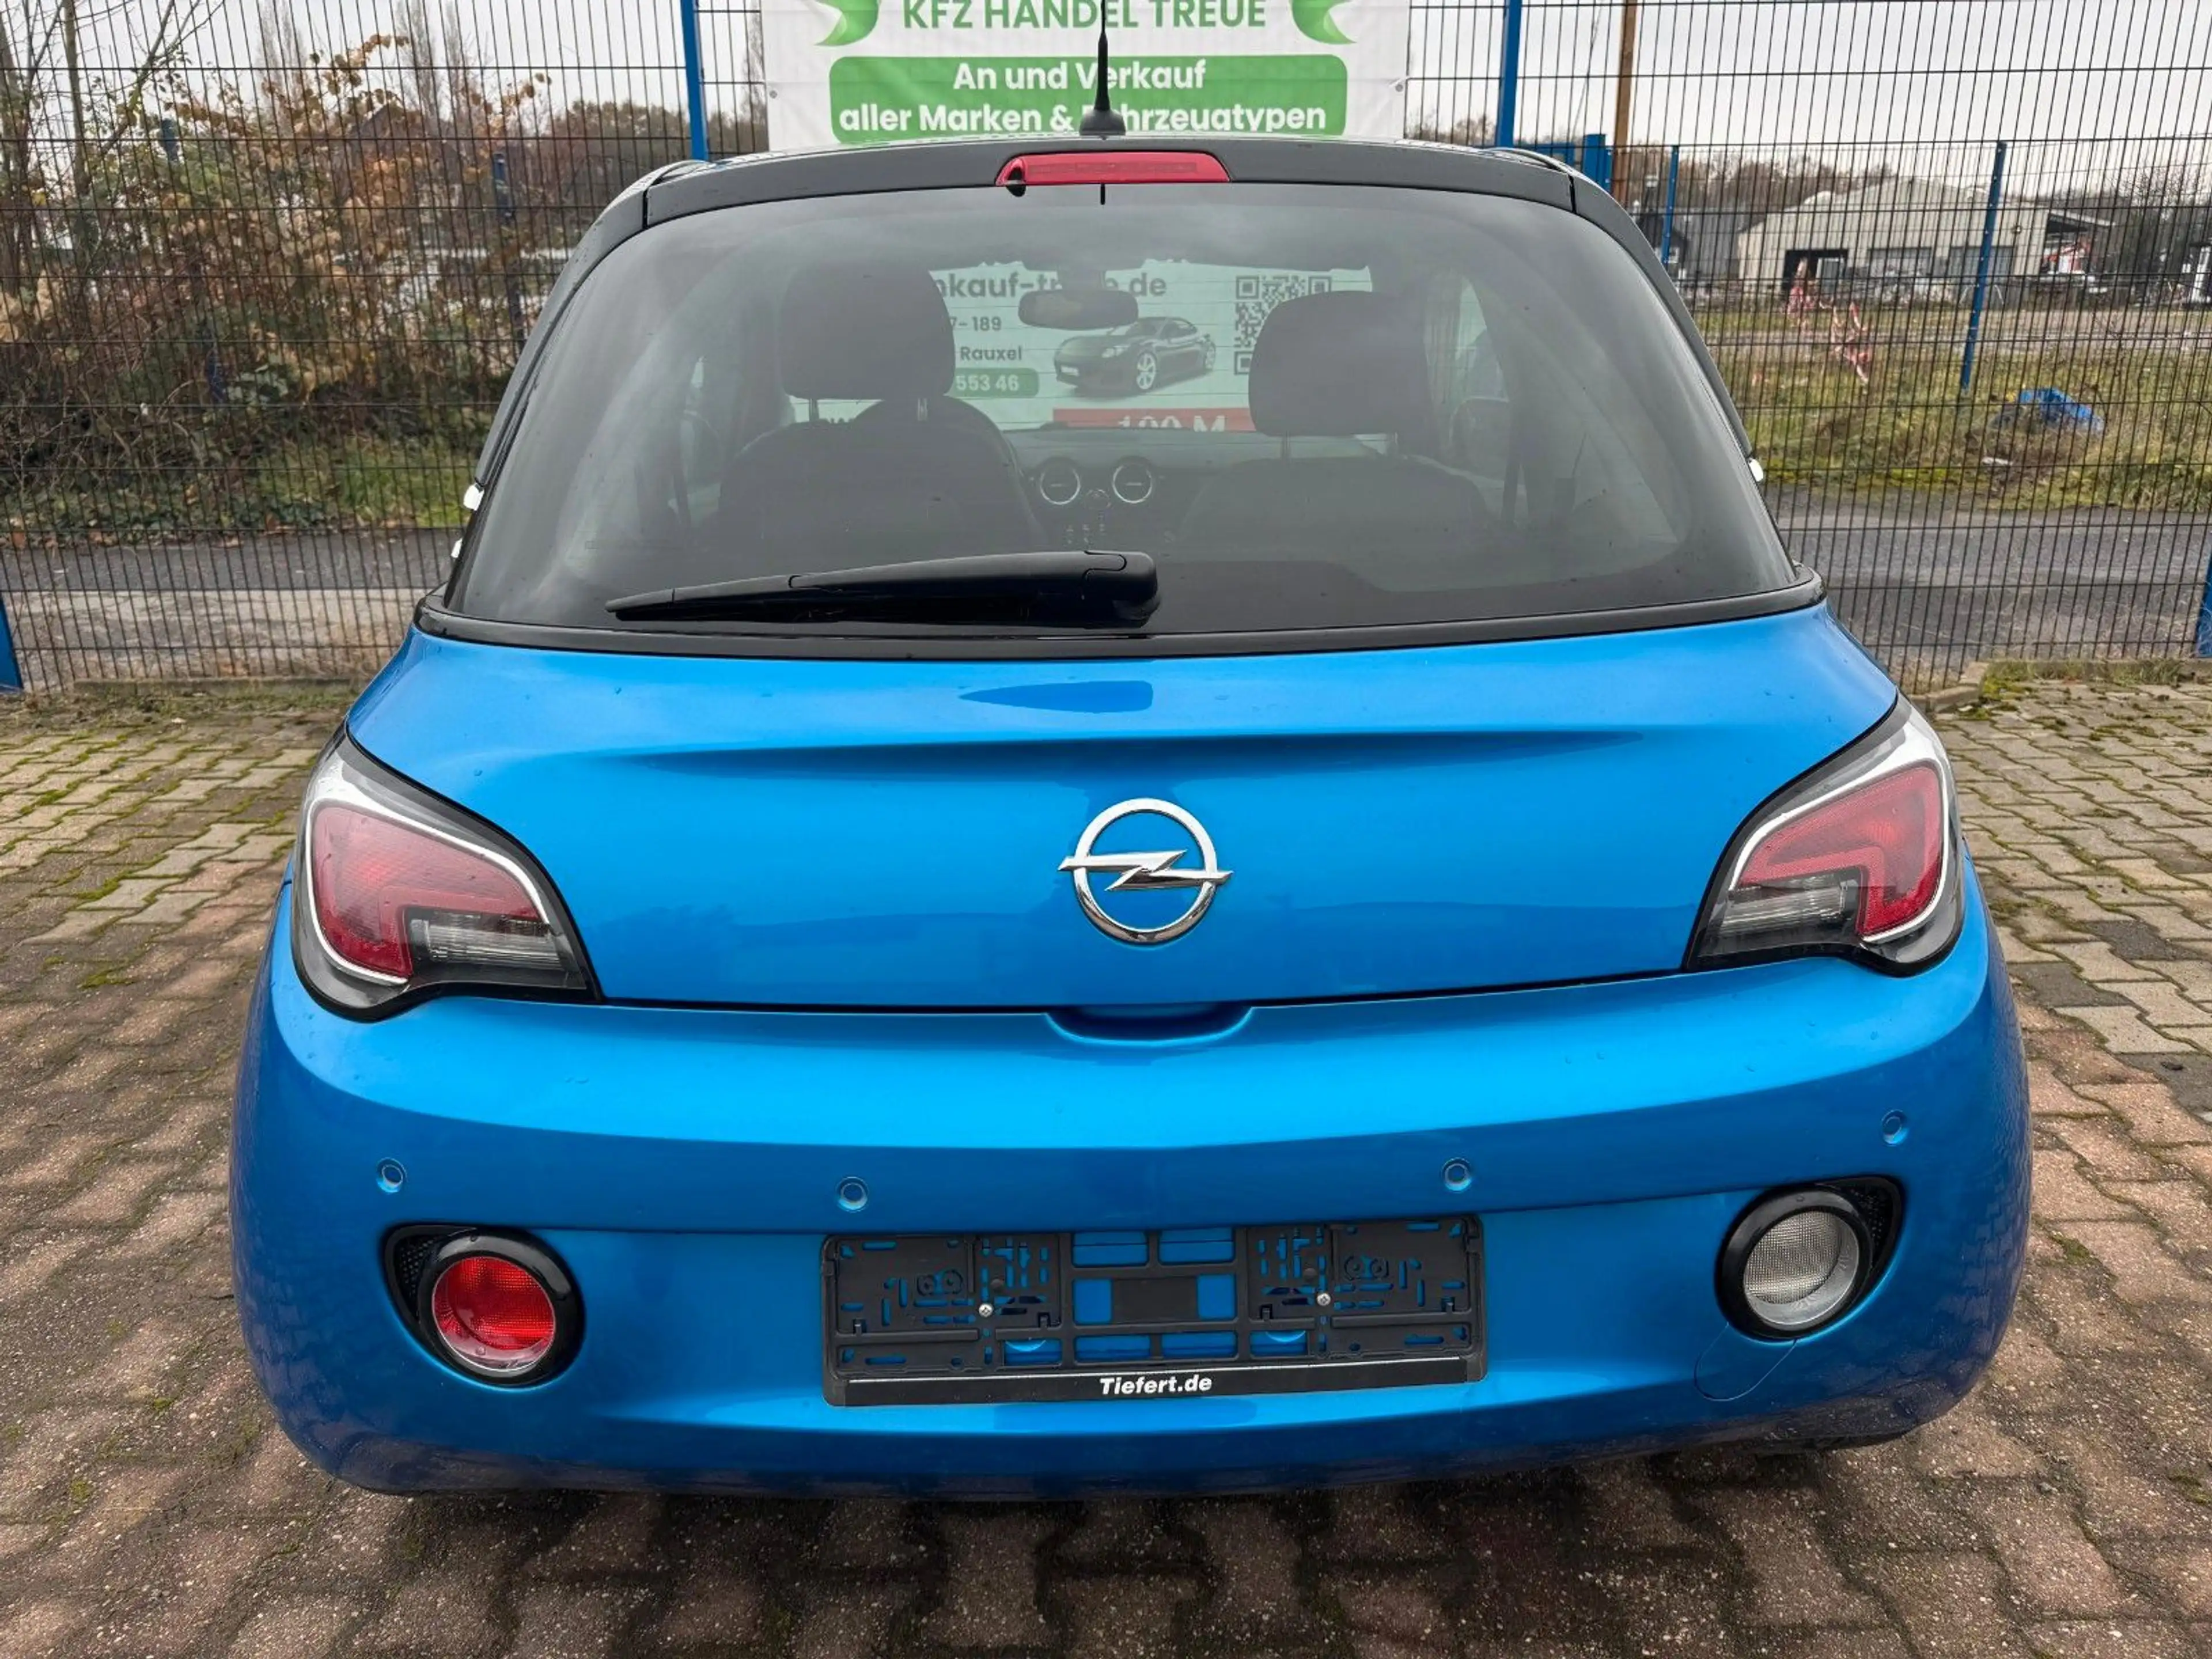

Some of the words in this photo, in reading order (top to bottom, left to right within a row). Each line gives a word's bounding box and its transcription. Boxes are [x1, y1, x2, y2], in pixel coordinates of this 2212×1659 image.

[903, 0, 973, 28] KFZ
[984, 0, 1139, 28] HANDEL
[1149, 0, 1266, 27] TREUE
[953, 63, 997, 90] An
[1005, 62, 1067, 90] und
[1075, 59, 1206, 89] Verkauf
[839, 103, 912, 131] aller
[919, 104, 1041, 131] Marken
[1050, 104, 1075, 131] &
[960, 346, 1022, 361] Rauxel
[995, 374, 1020, 392] 46
[1099, 1374, 1212, 1395] Tiefert.de
